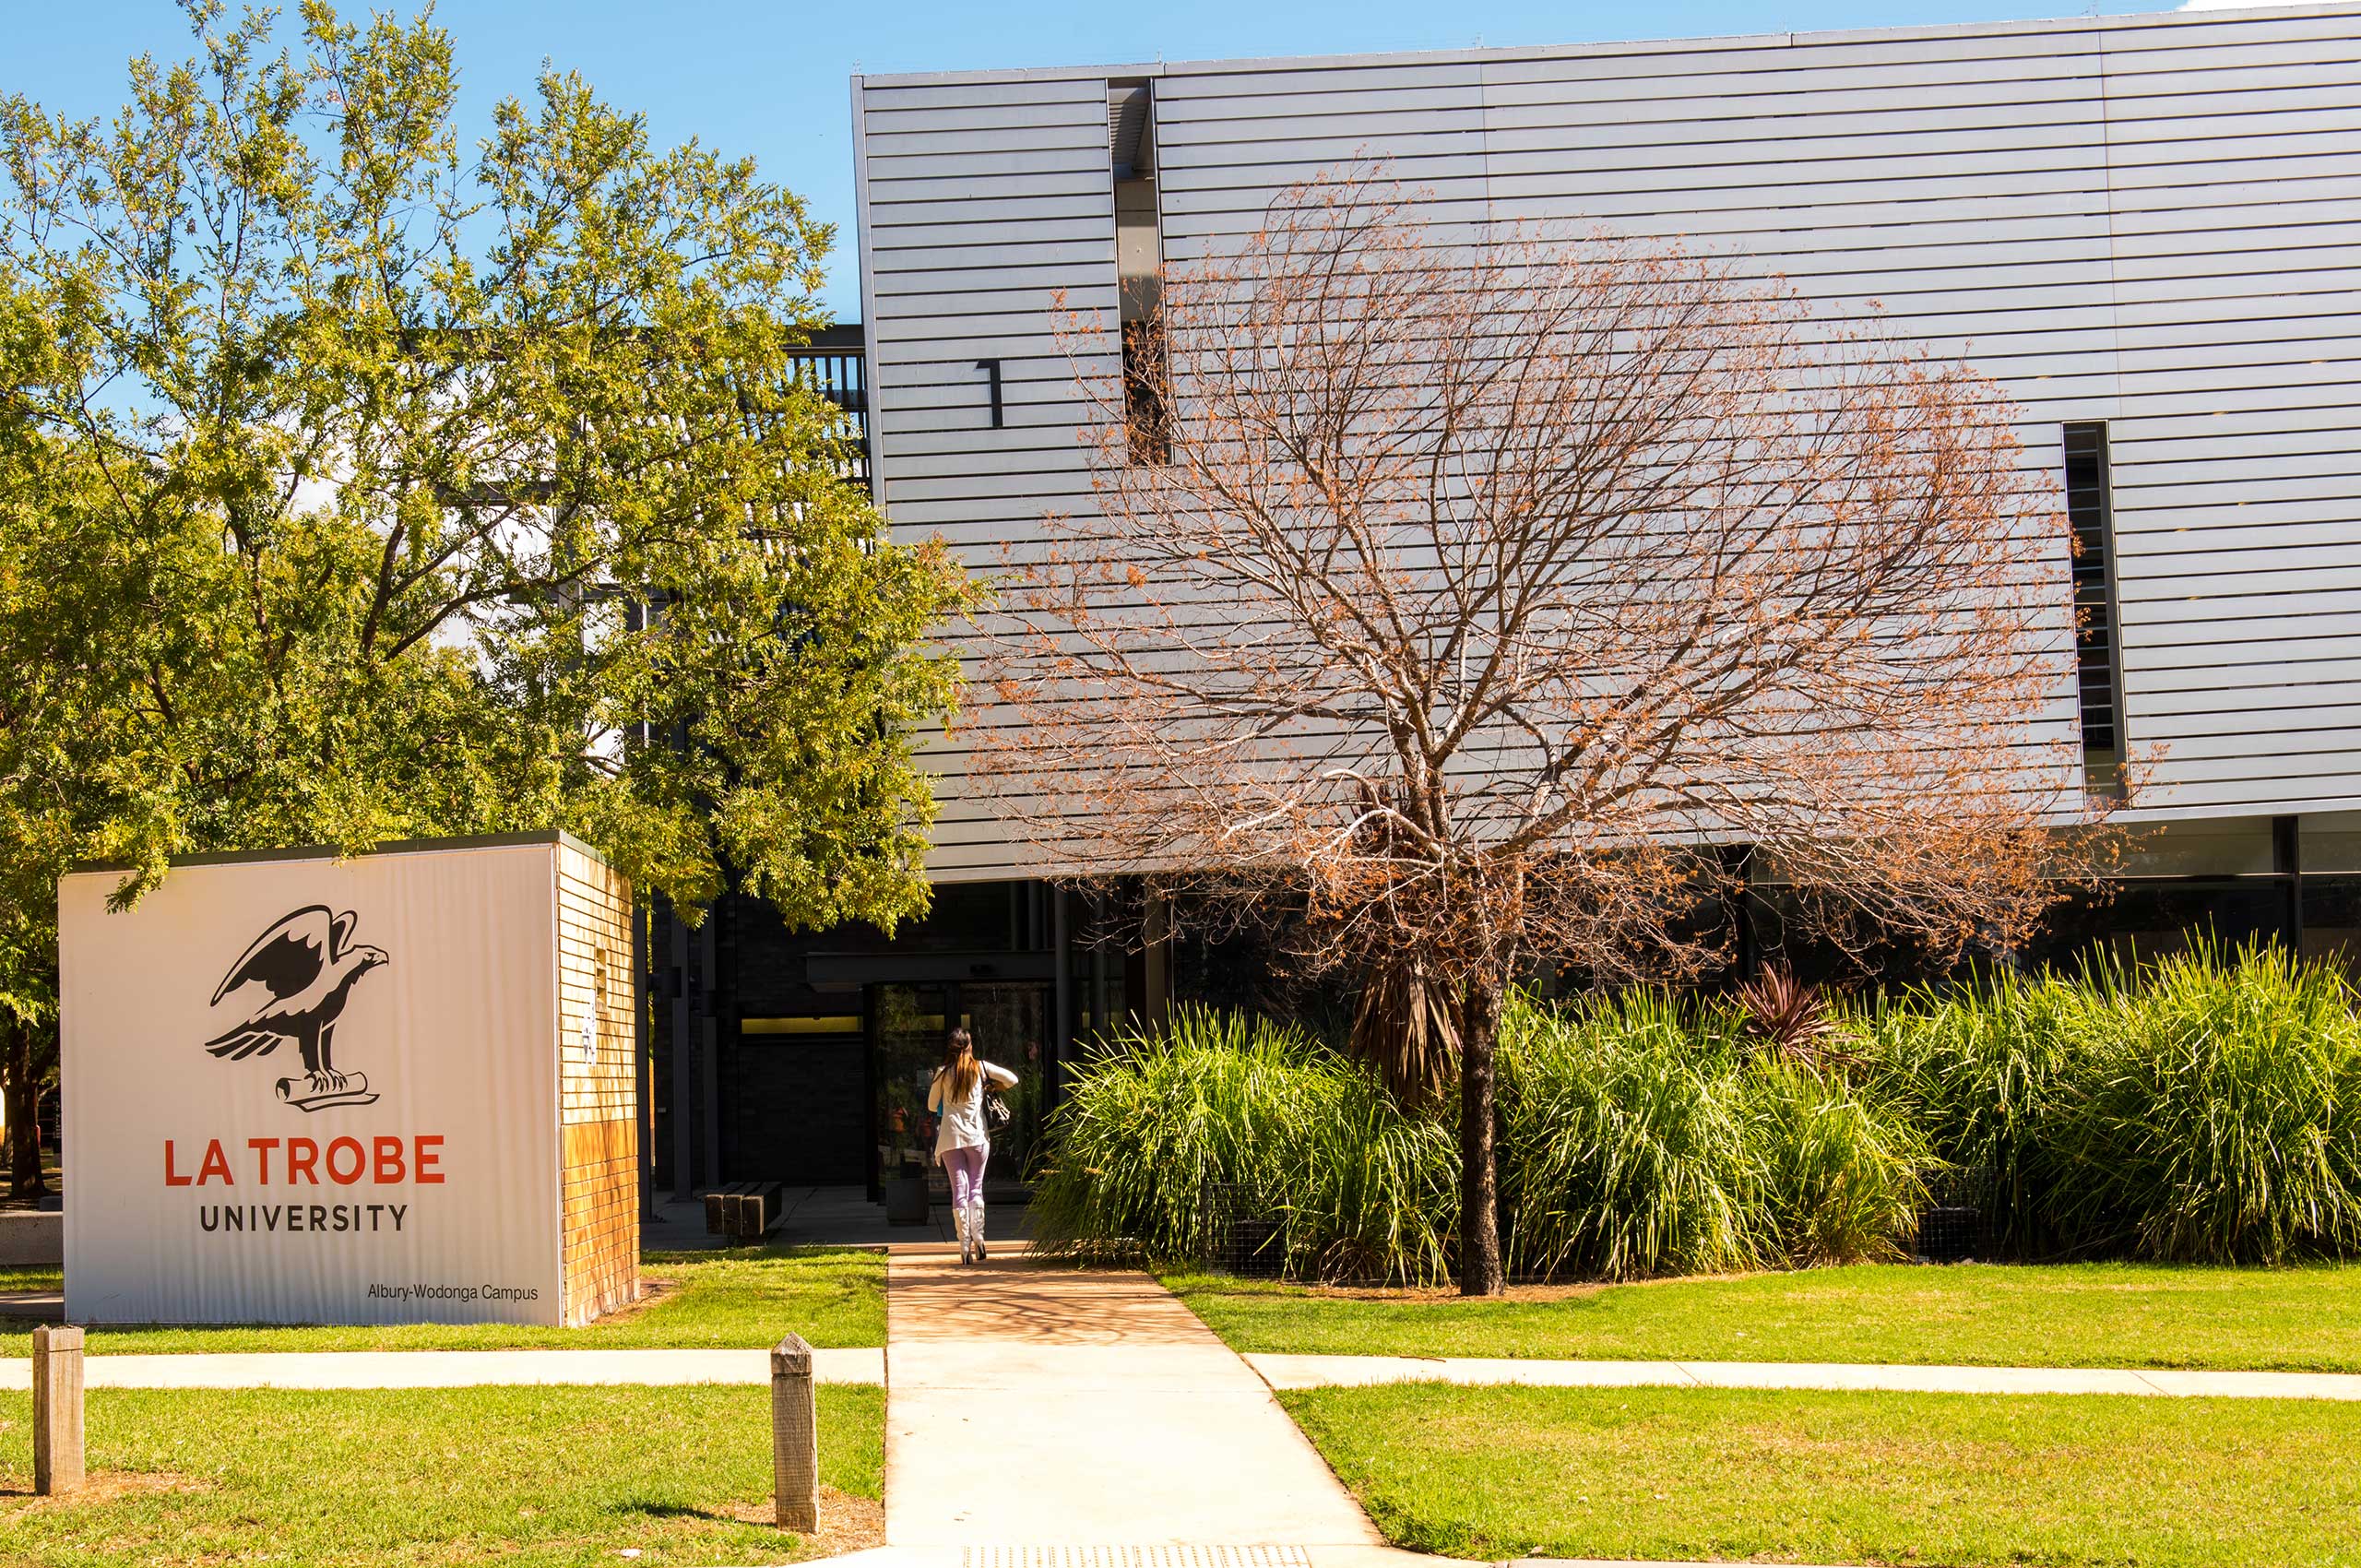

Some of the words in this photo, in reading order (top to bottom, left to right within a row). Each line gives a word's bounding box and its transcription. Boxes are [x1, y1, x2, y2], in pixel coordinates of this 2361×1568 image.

[975, 358, 1003, 429] 1
[165, 1138, 234, 1186] LA
[248, 1135, 445, 1185] TROBE
[200, 1205, 408, 1231] UNIVERSITY
[368, 1283, 478, 1302] Albury-Wodonga
[481, 1284, 539, 1303] Campus
